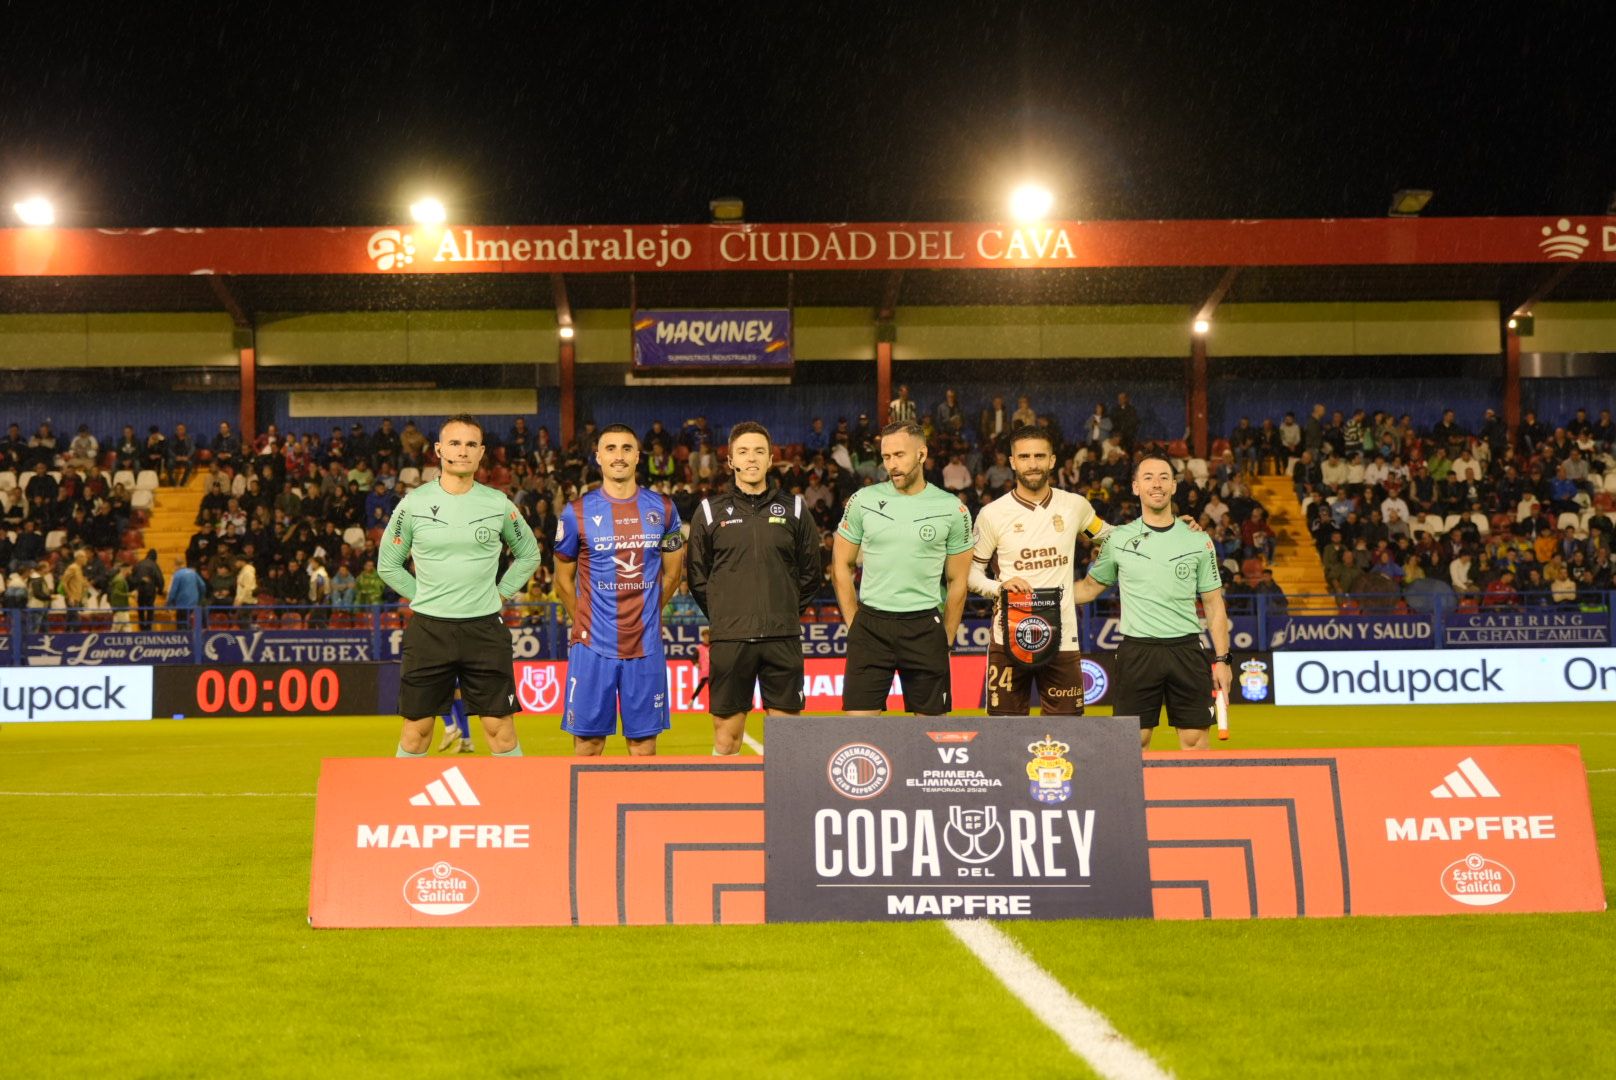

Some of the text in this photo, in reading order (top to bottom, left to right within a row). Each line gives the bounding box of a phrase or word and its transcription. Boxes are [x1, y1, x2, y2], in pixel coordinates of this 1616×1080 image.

[433, 228, 692, 267] Almendralejo
[720, 229, 1076, 261] CIUDAD DEL CAVA
[656, 320, 773, 346] MAQUINEX
[1013, 555, 1069, 571] Canaria
[1020, 547, 1057, 560] Gran
[1290, 620, 1431, 642] JAMÓN Y SALUD
[1469, 615, 1583, 627] CATERING
[104, 635, 189, 645] CLUB GIMNASIA
[1447, 628, 1606, 643] LA GRAN FAMILIA
[66, 633, 191, 666] Laura Campos
[235, 631, 370, 663] VALTUBEX
[988, 665, 1013, 691] 24
[1296, 658, 1504, 701] Ondupack
[197, 668, 339, 712] 00:00
[570, 677, 577, 703] 7
[834, 747, 883, 766] EXTREMADURA
[937, 747, 969, 764] VS
[906, 778, 1002, 787] ELIMINATORIA
[923, 770, 985, 778] PRIMERA
[356, 824, 530, 849] MAPFRE
[1385, 815, 1556, 842] MAPFRE
[815, 808, 941, 878] COPA
[1010, 809, 1095, 878] REY
[957, 867, 996, 877] DEL
[1453, 868, 1502, 881] Estrella
[416, 877, 467, 890] Estrella
[1456, 880, 1502, 893] Galicia
[417, 889, 464, 902] Galicia
[887, 895, 1031, 915] MAPFRE
